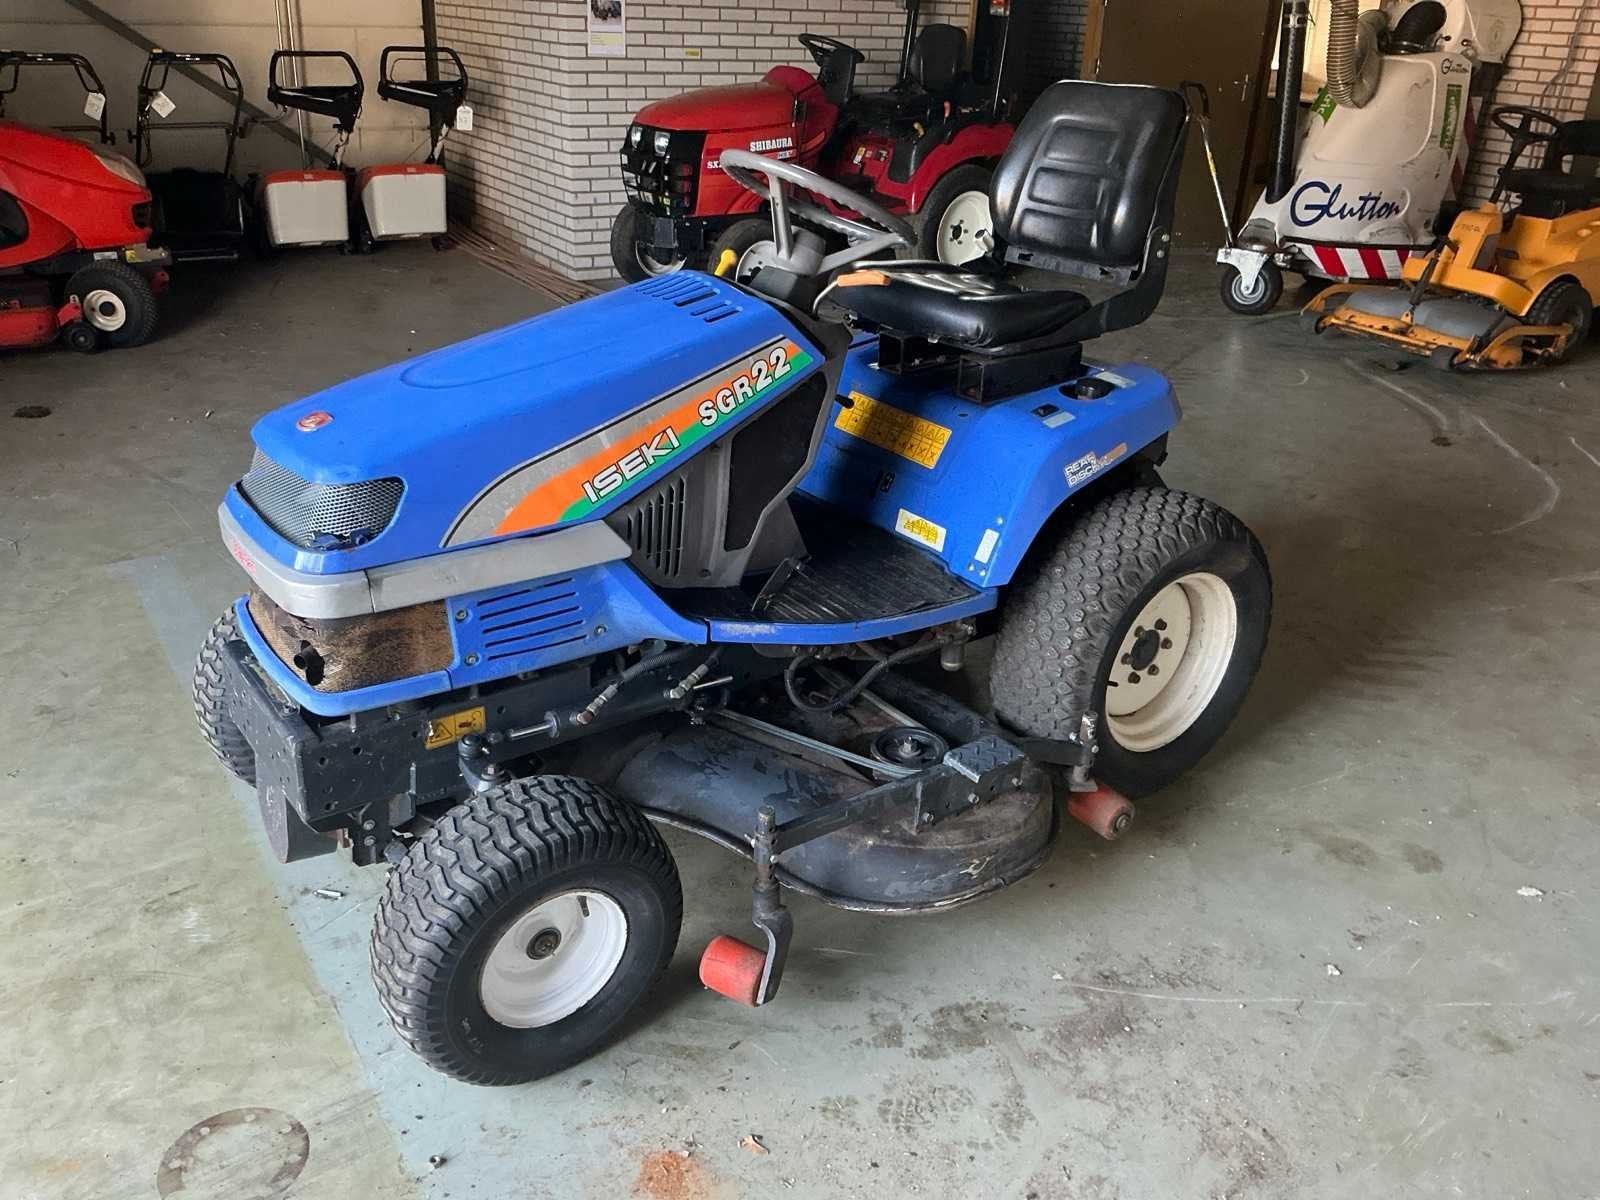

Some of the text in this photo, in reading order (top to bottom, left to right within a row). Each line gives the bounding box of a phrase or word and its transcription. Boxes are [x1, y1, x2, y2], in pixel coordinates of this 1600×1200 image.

[750, 137, 793, 152] SHIBAURA
[1290, 181, 1401, 227] Glutton
[698, 347, 792, 427] SGR22
[582, 426, 681, 504] ISEKI
[1064, 452, 1097, 477] REAR
